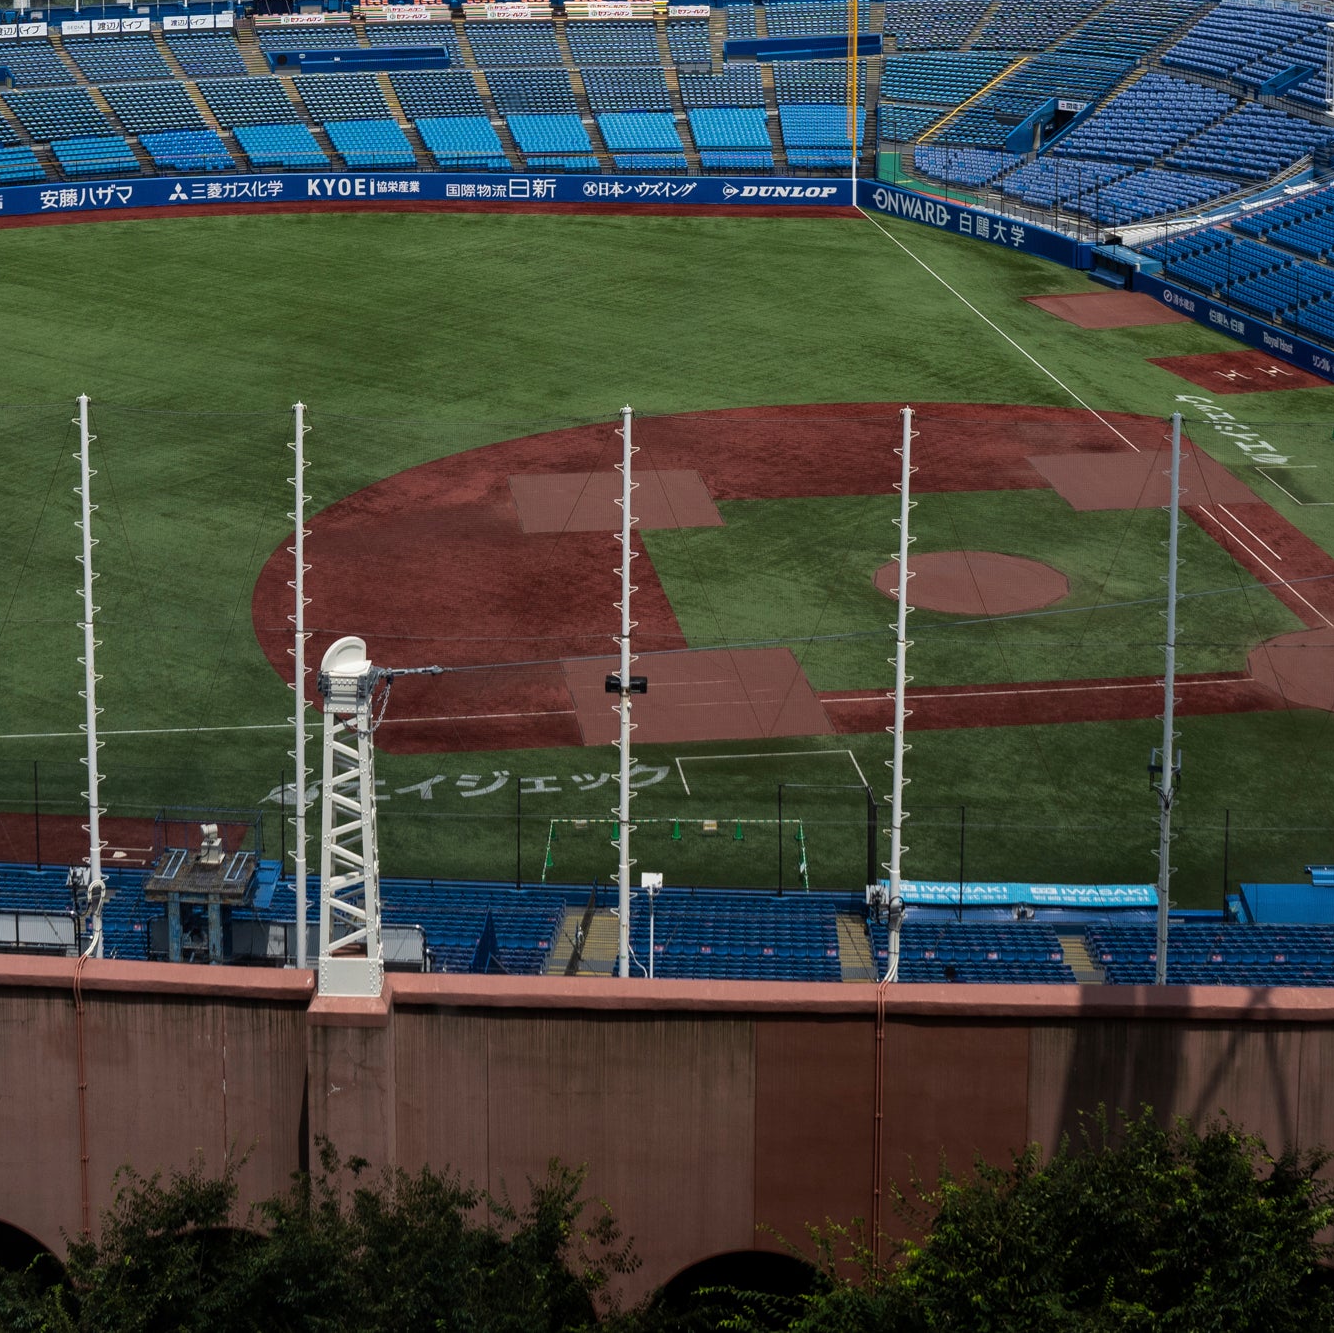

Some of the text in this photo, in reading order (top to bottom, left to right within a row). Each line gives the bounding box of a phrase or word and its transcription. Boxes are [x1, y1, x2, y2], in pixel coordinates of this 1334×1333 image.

[40, 185, 133, 210] 安藤ハザマ
[190, 179, 284, 200] 三菱ガス化学
[307, 178, 420, 197] KYOEI 協栄産業
[445, 178, 556, 199] 国際物流 日新
[598, 181, 697, 198] 日本ハウズイング
[740, 185, 837, 198] DUNLOP
[872, 187, 951, 227] ONWARD
[1263, 332, 1294, 355] Royal Host
[921, 885, 1008, 894] IWASAKI
[1061, 887, 1149, 896] IWASAKI
